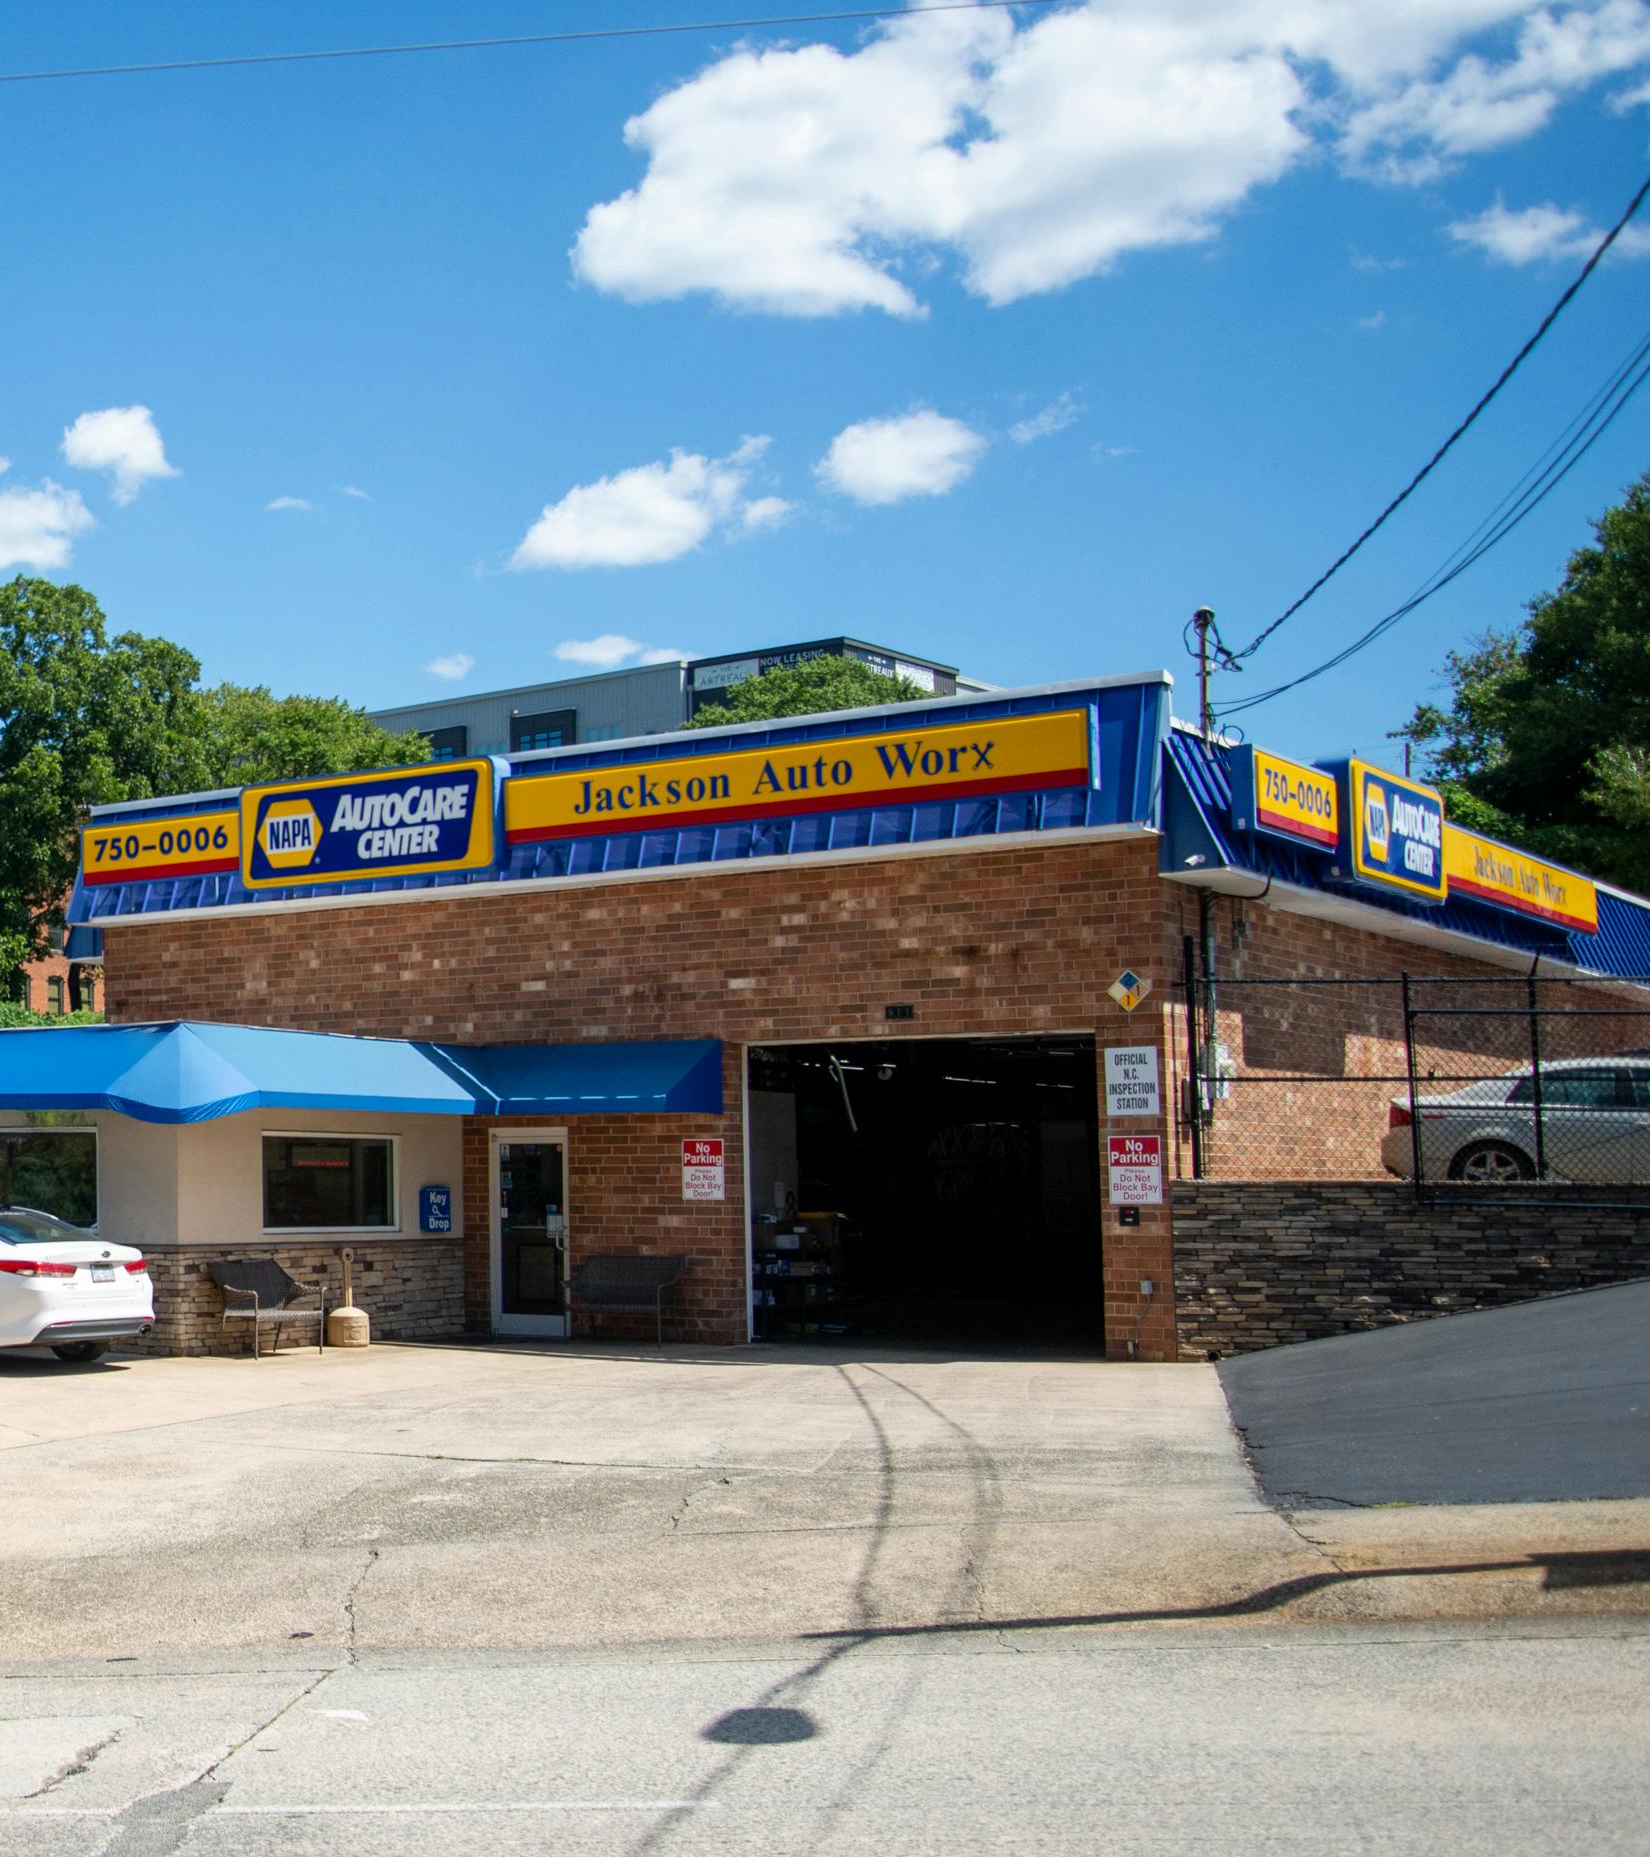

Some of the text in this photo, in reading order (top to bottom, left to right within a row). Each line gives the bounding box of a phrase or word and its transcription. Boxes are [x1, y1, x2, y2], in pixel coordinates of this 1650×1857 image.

[760, 655, 781, 667] NOW
[783, 649, 825, 664] LEASING
[574, 740, 995, 815] Jackson Auto Worx
[1264, 768, 1333, 820] 750-0006
[269, 816, 312, 852] NAPA
[93, 824, 229, 863] 750-0006
[357, 824, 440, 860] CENTER
[1404, 839, 1434, 878] CENTER
[1473, 845, 1514, 888] Jackson
[1518, 862, 1539, 898] Auto
[1114, 1053, 1148, 1066] OFFICIAL
[1123, 1068, 1140, 1080] N.C.
[1109, 1082, 1156, 1095] INSPECTION
[1116, 1097, 1149, 1110] STATION
[696, 1142, 710, 1153] No
[1125, 1139, 1143, 1152] No
[684, 1153, 722, 1166] Parking
[1111, 1151, 1159, 1166] Parking
[1119, 1174, 1150, 1182] Do Not
[685, 1182, 721, 1191] Block Bay
[1113, 1183, 1158, 1193] Block Bay
[430, 1192, 446, 1206] Key
[1123, 1192, 1148, 1200] Door!
[429, 1217, 449, 1231] Drop
